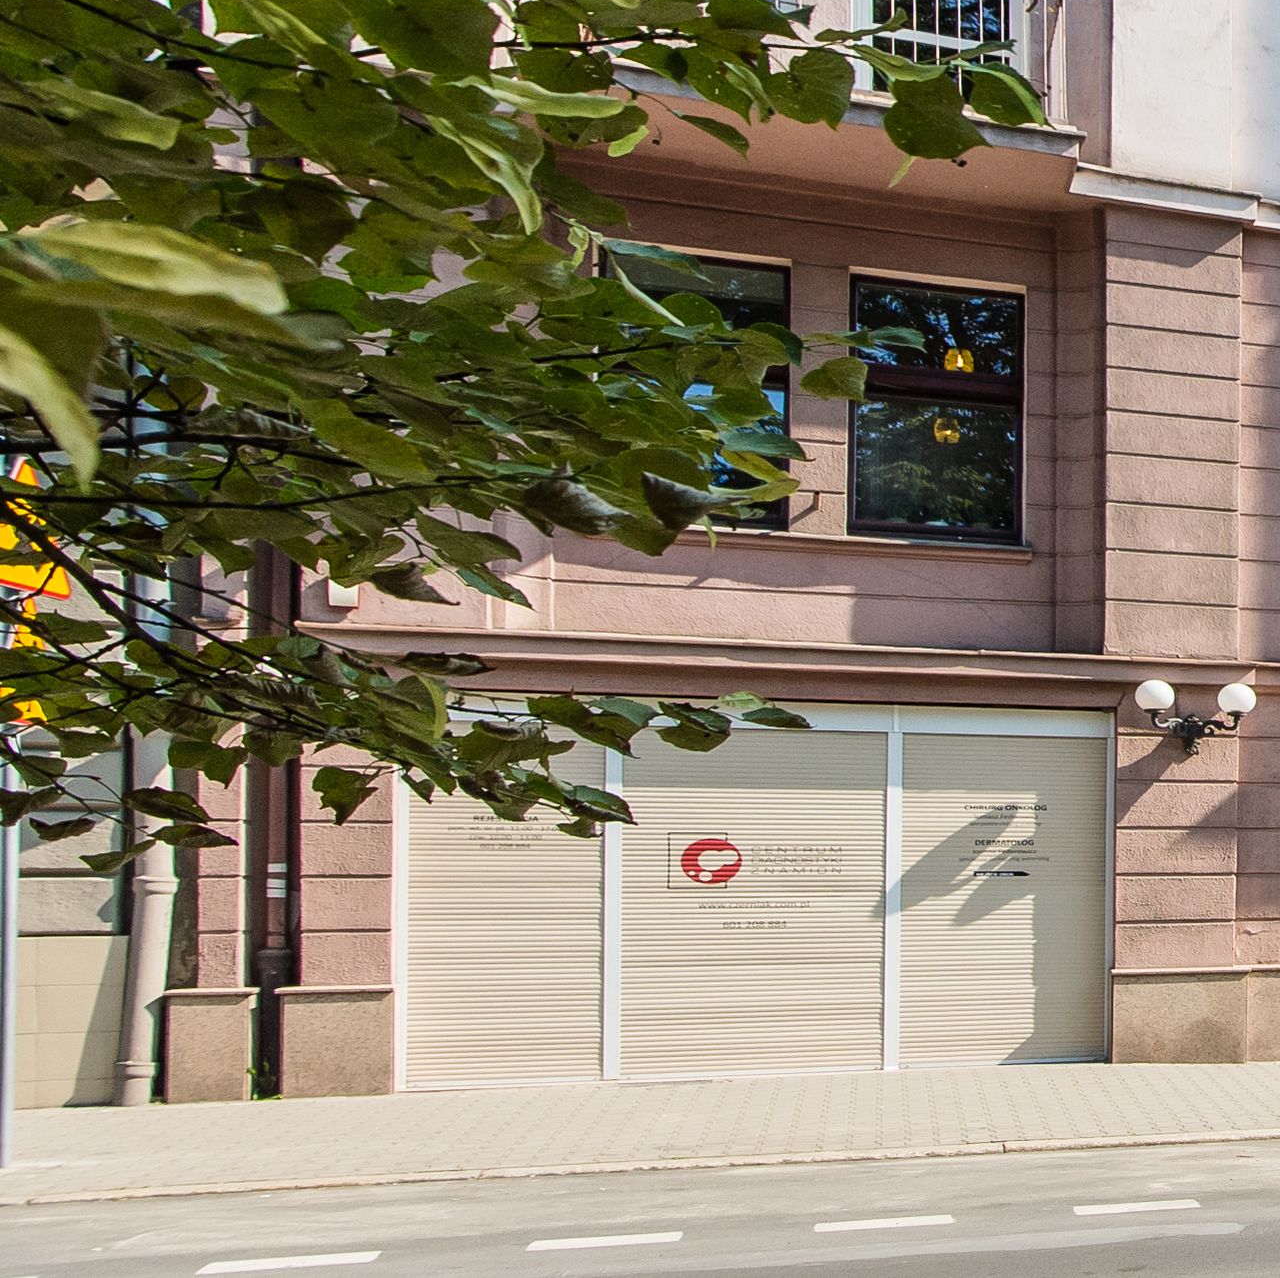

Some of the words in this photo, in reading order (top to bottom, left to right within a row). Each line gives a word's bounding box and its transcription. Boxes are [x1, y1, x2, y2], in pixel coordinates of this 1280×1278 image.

[751, 846, 842, 854] CENTRUM
[698, 900, 811, 909] www.czerniak.com.pl
[723, 921, 742, 929] 601
